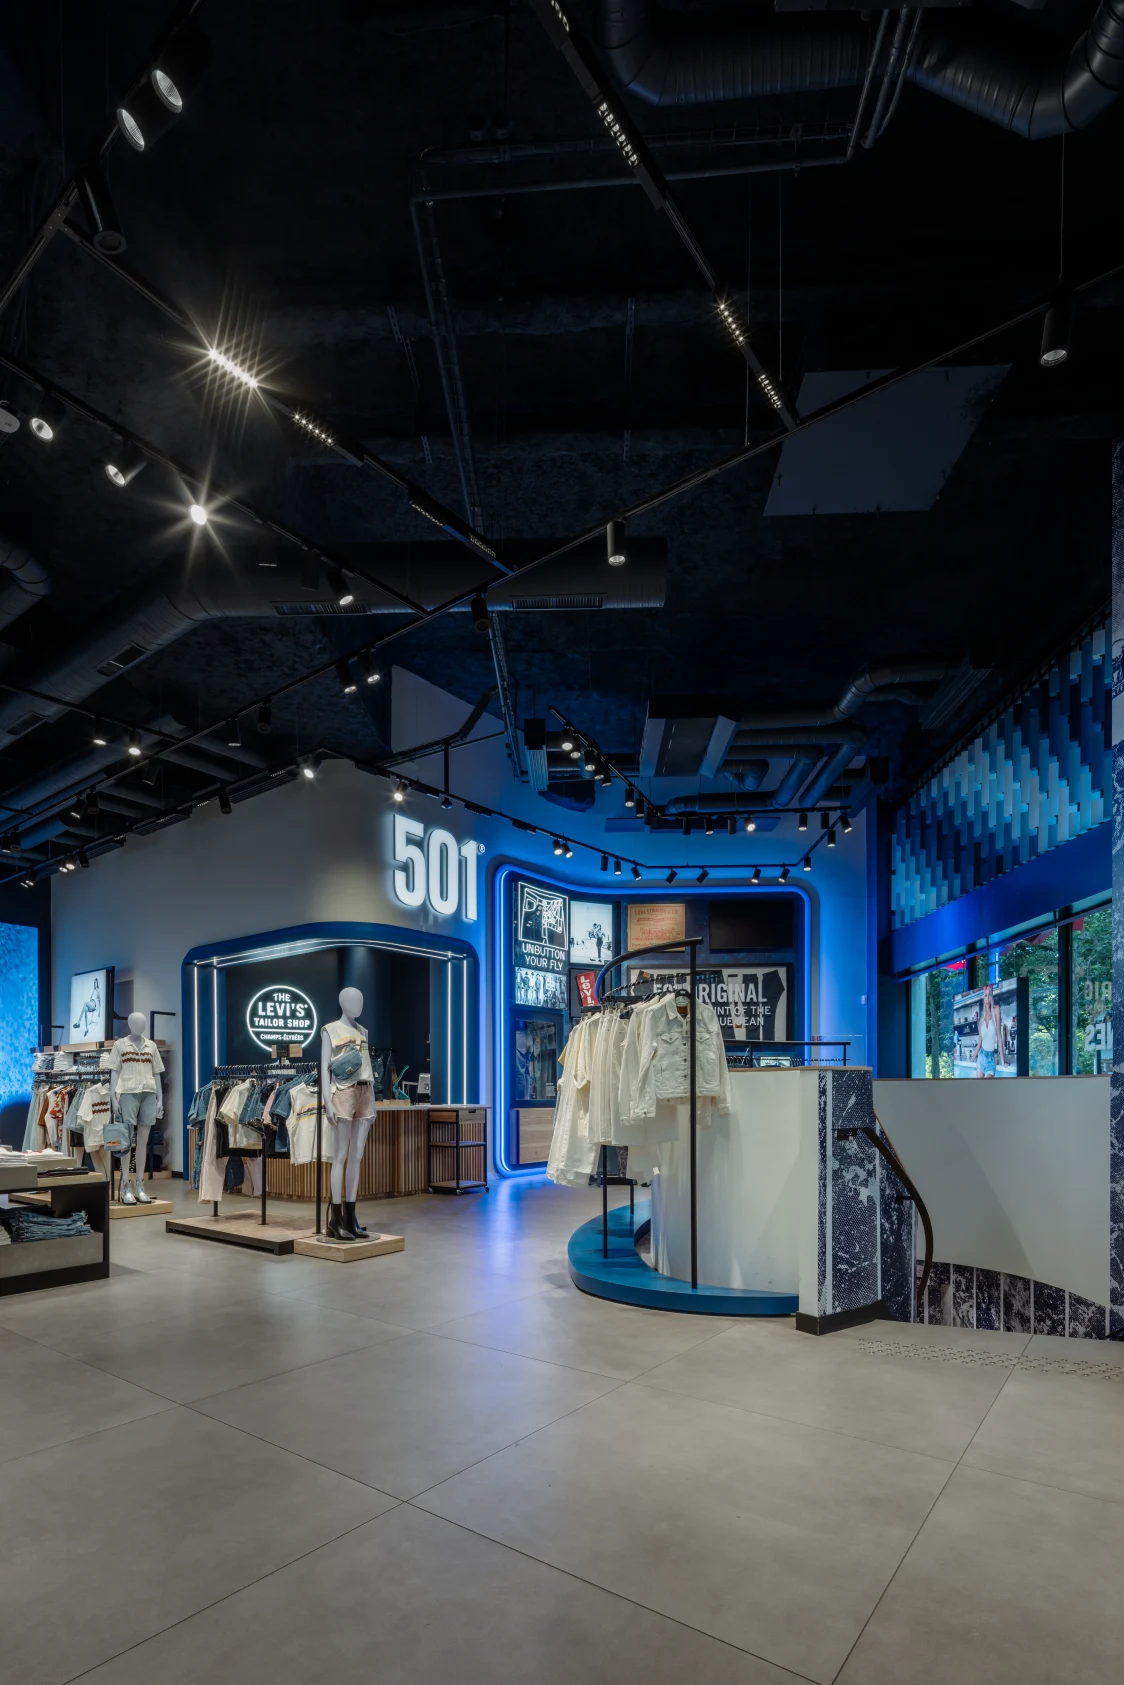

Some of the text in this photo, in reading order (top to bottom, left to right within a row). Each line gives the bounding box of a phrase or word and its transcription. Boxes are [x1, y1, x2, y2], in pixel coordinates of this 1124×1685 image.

[522, 942, 565, 961] UNBUTTON
[524, 954, 563, 971] YOUR FLY
[273, 993, 291, 1001] THE
[696, 983, 767, 1002] RIGINAL
[734, 1006, 748, 1015] OF
[750, 1006, 771, 1015] THE
[254, 1018, 310, 1027] TAILOR SHOP
[736, 1017, 764, 1026] JEAN
